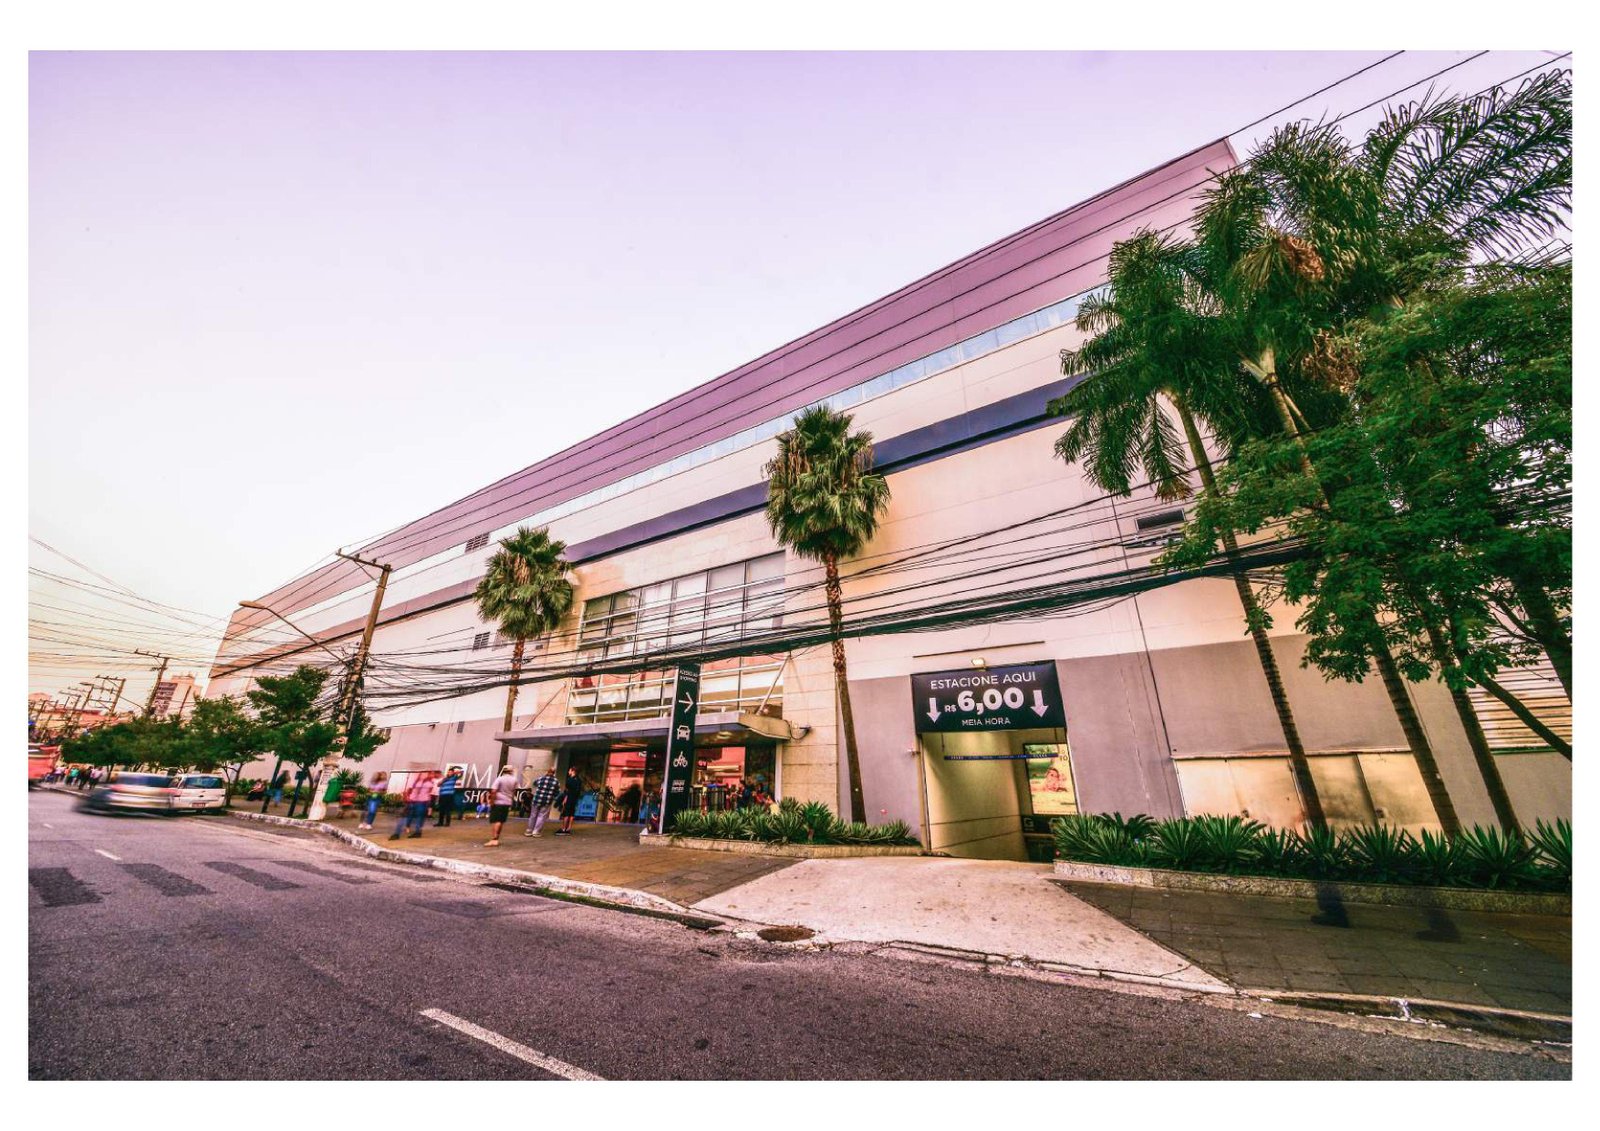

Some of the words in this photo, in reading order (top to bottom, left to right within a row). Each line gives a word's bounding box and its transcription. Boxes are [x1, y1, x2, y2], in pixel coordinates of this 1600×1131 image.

[930, 675, 998, 690] ESTACIONE
[1003, 671, 1036, 684] AQUI
[944, 704, 957, 713] R$
[957, 687, 1024, 715] 6,00
[962, 717, 983, 726] MEIA
[985, 717, 1011, 725] HORA
